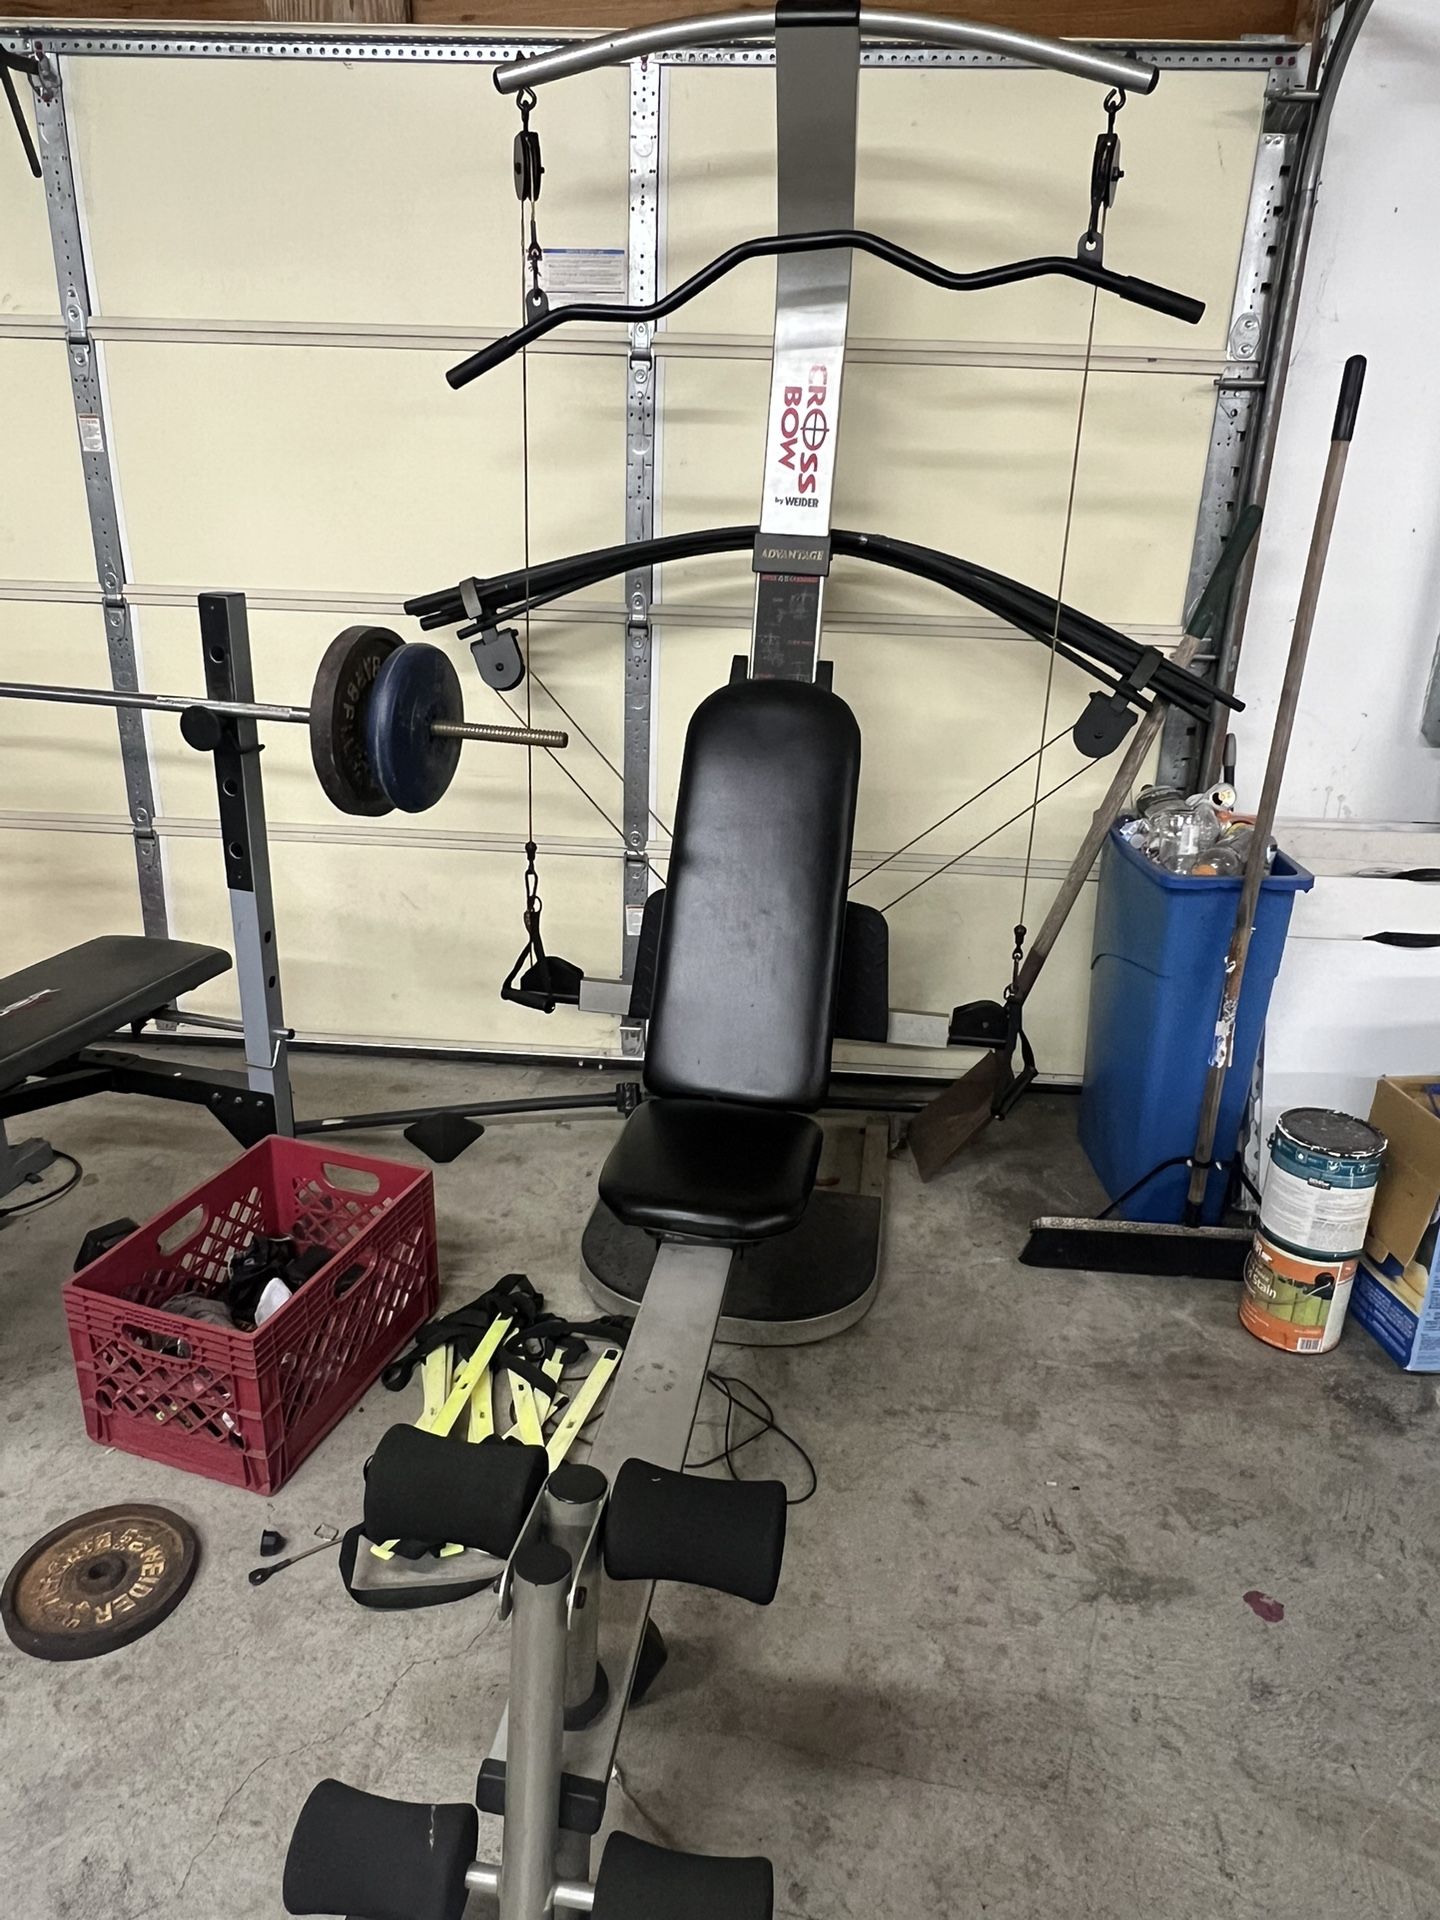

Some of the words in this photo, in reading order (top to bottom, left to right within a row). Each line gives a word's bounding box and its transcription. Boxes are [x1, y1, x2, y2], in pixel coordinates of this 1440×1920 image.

[778, 386, 803, 471] BOW
[797, 362, 830, 494] CROSS
[774, 496, 784, 506] by
[785, 496, 819, 508] WEIDER
[762, 548, 825, 561] ADVANTAGE
[1253, 1274, 1277, 1299] Stain
[95, 1544, 167, 1625] WEIDER
